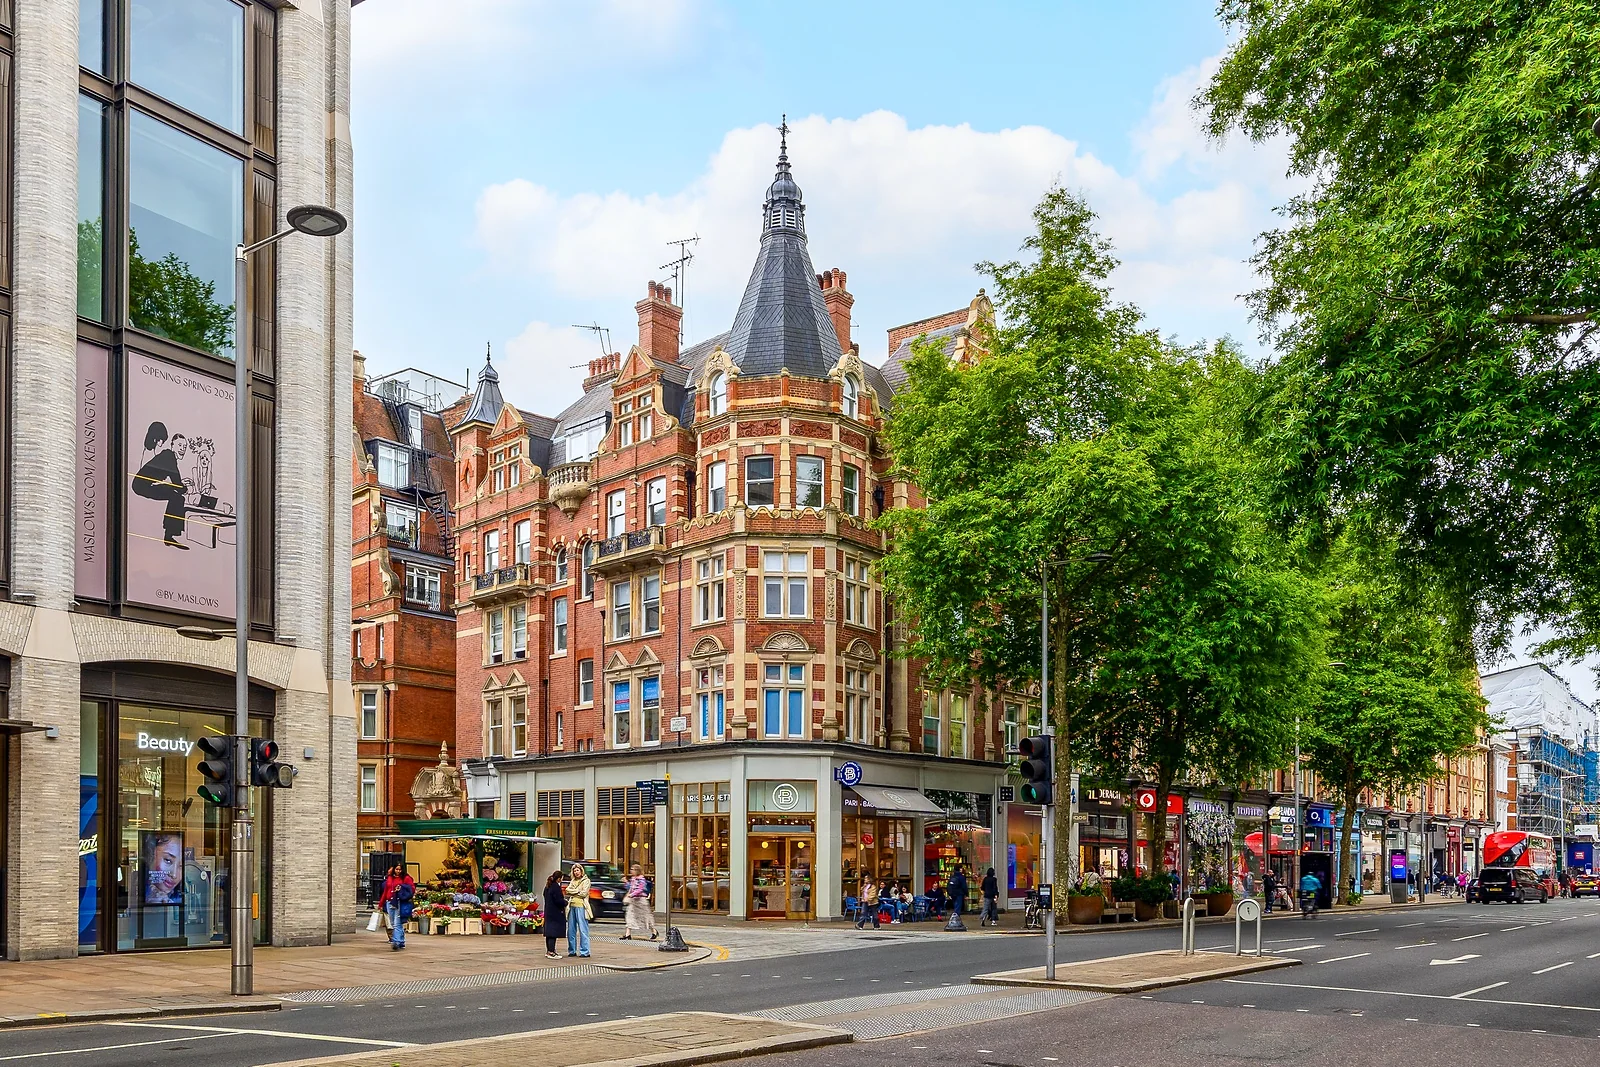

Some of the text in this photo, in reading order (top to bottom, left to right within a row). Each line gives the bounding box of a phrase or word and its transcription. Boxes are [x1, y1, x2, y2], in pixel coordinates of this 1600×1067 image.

[141, 364, 235, 402] OPENING SPRING 2026
[83, 378, 96, 564] MASLOWS.COM/KENSINGTON
[155, 588, 219, 609] @BY_MASLOWS
[138, 732, 194, 757] Beauty
[1311, 811, 1321, 821] O2
